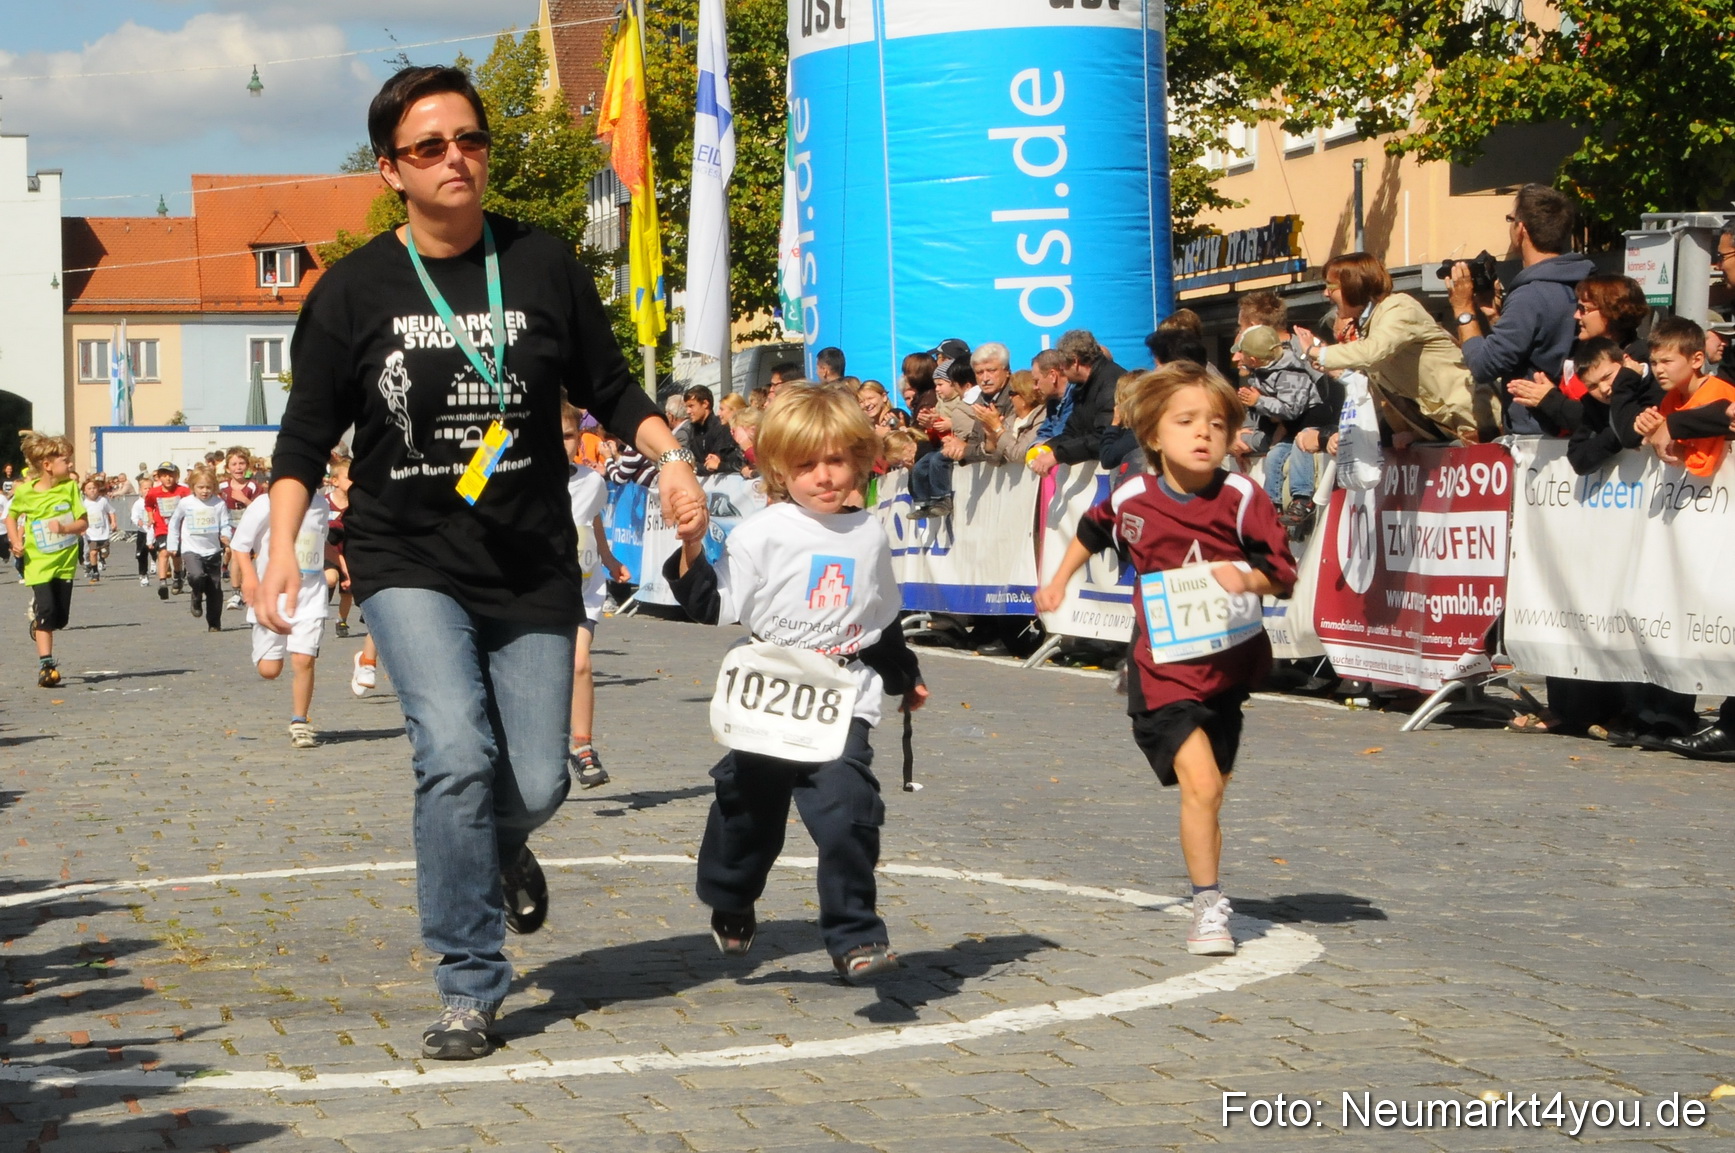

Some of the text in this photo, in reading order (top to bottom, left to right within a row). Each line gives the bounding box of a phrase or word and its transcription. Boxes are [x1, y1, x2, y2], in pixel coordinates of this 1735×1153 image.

[393, 311, 528, 335] NEUMARKER
[404, 329, 518, 350] STADLAF
[1524, 467, 1729, 514] Gute Ideen haben
[1410, 525, 1495, 560] VRKAUFEN
[1170, 576, 1207, 594] Linus
[1072, 610, 1101, 626] MICRO
[1177, 592, 1249, 627] 7139
[772, 614, 842, 636] neumarkt
[726, 667, 842, 725] 10208
